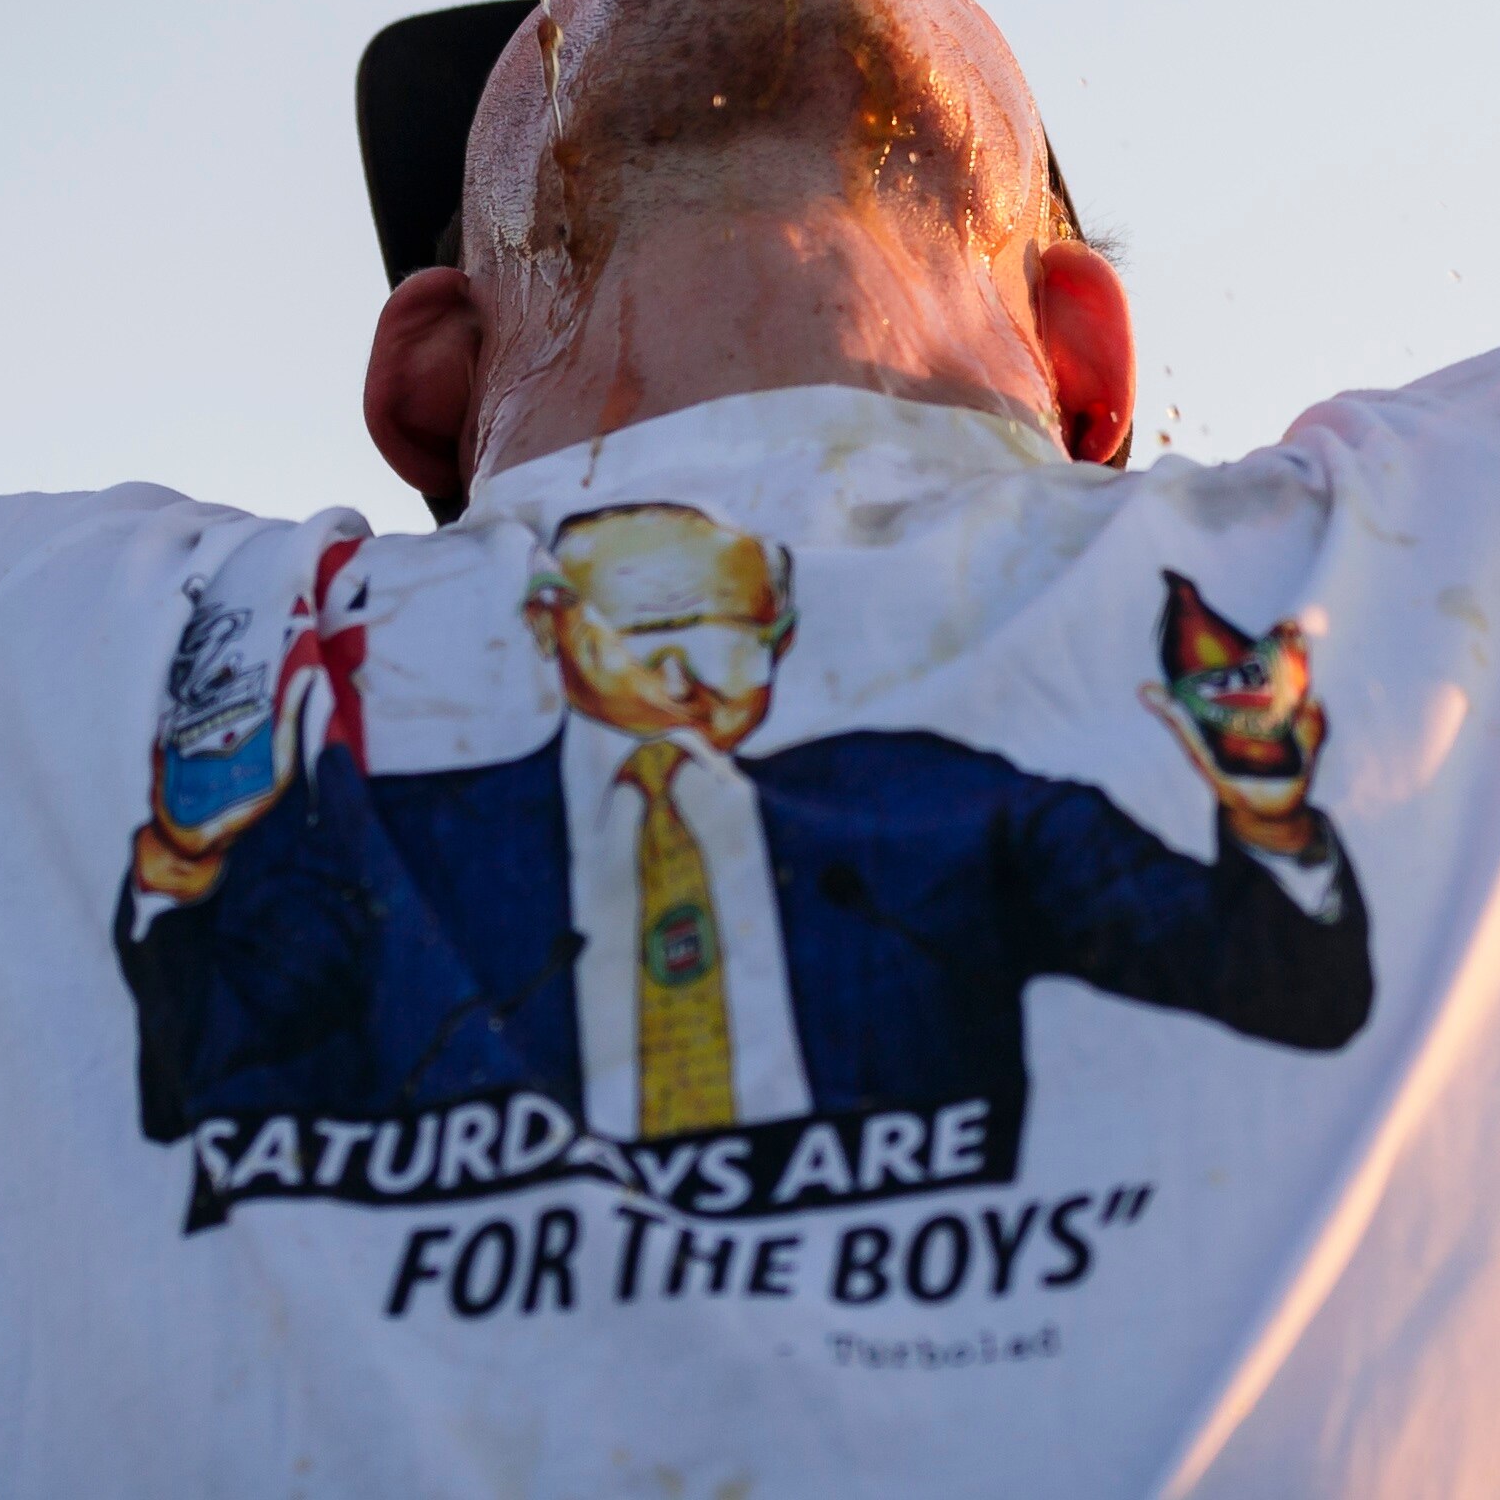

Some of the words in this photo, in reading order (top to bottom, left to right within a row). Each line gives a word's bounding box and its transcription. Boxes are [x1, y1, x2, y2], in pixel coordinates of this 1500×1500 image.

[772, 1100, 991, 1204] ARE
[384, 1206, 581, 1320] FOR
[612, 1204, 802, 1301] THE
